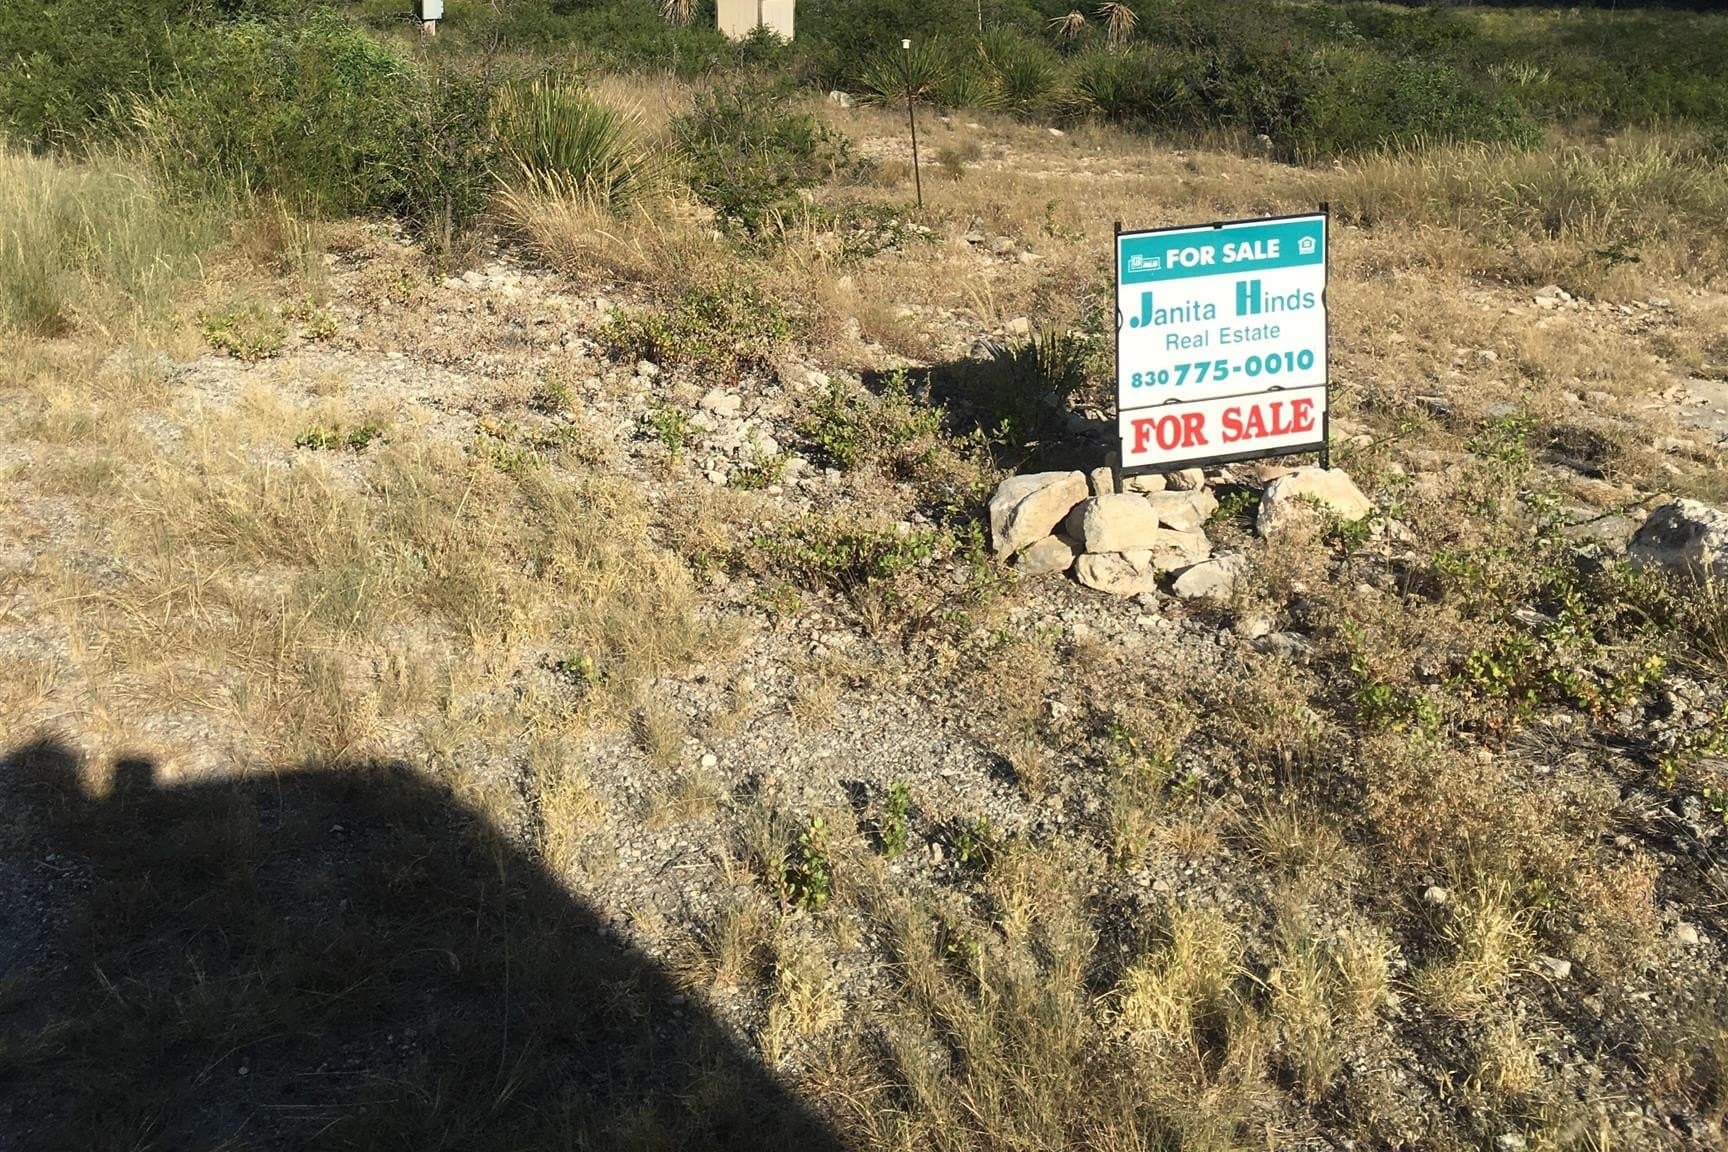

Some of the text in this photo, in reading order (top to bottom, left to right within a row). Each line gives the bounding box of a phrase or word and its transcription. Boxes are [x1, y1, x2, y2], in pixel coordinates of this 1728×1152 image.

[1166, 246, 1216, 269] FOR
[1222, 238, 1280, 263] SALE
[1129, 279, 1315, 328] Janita Hinds
[1166, 325, 1281, 351] Real Estate
[1130, 398, 1315, 454] FOR SALE
